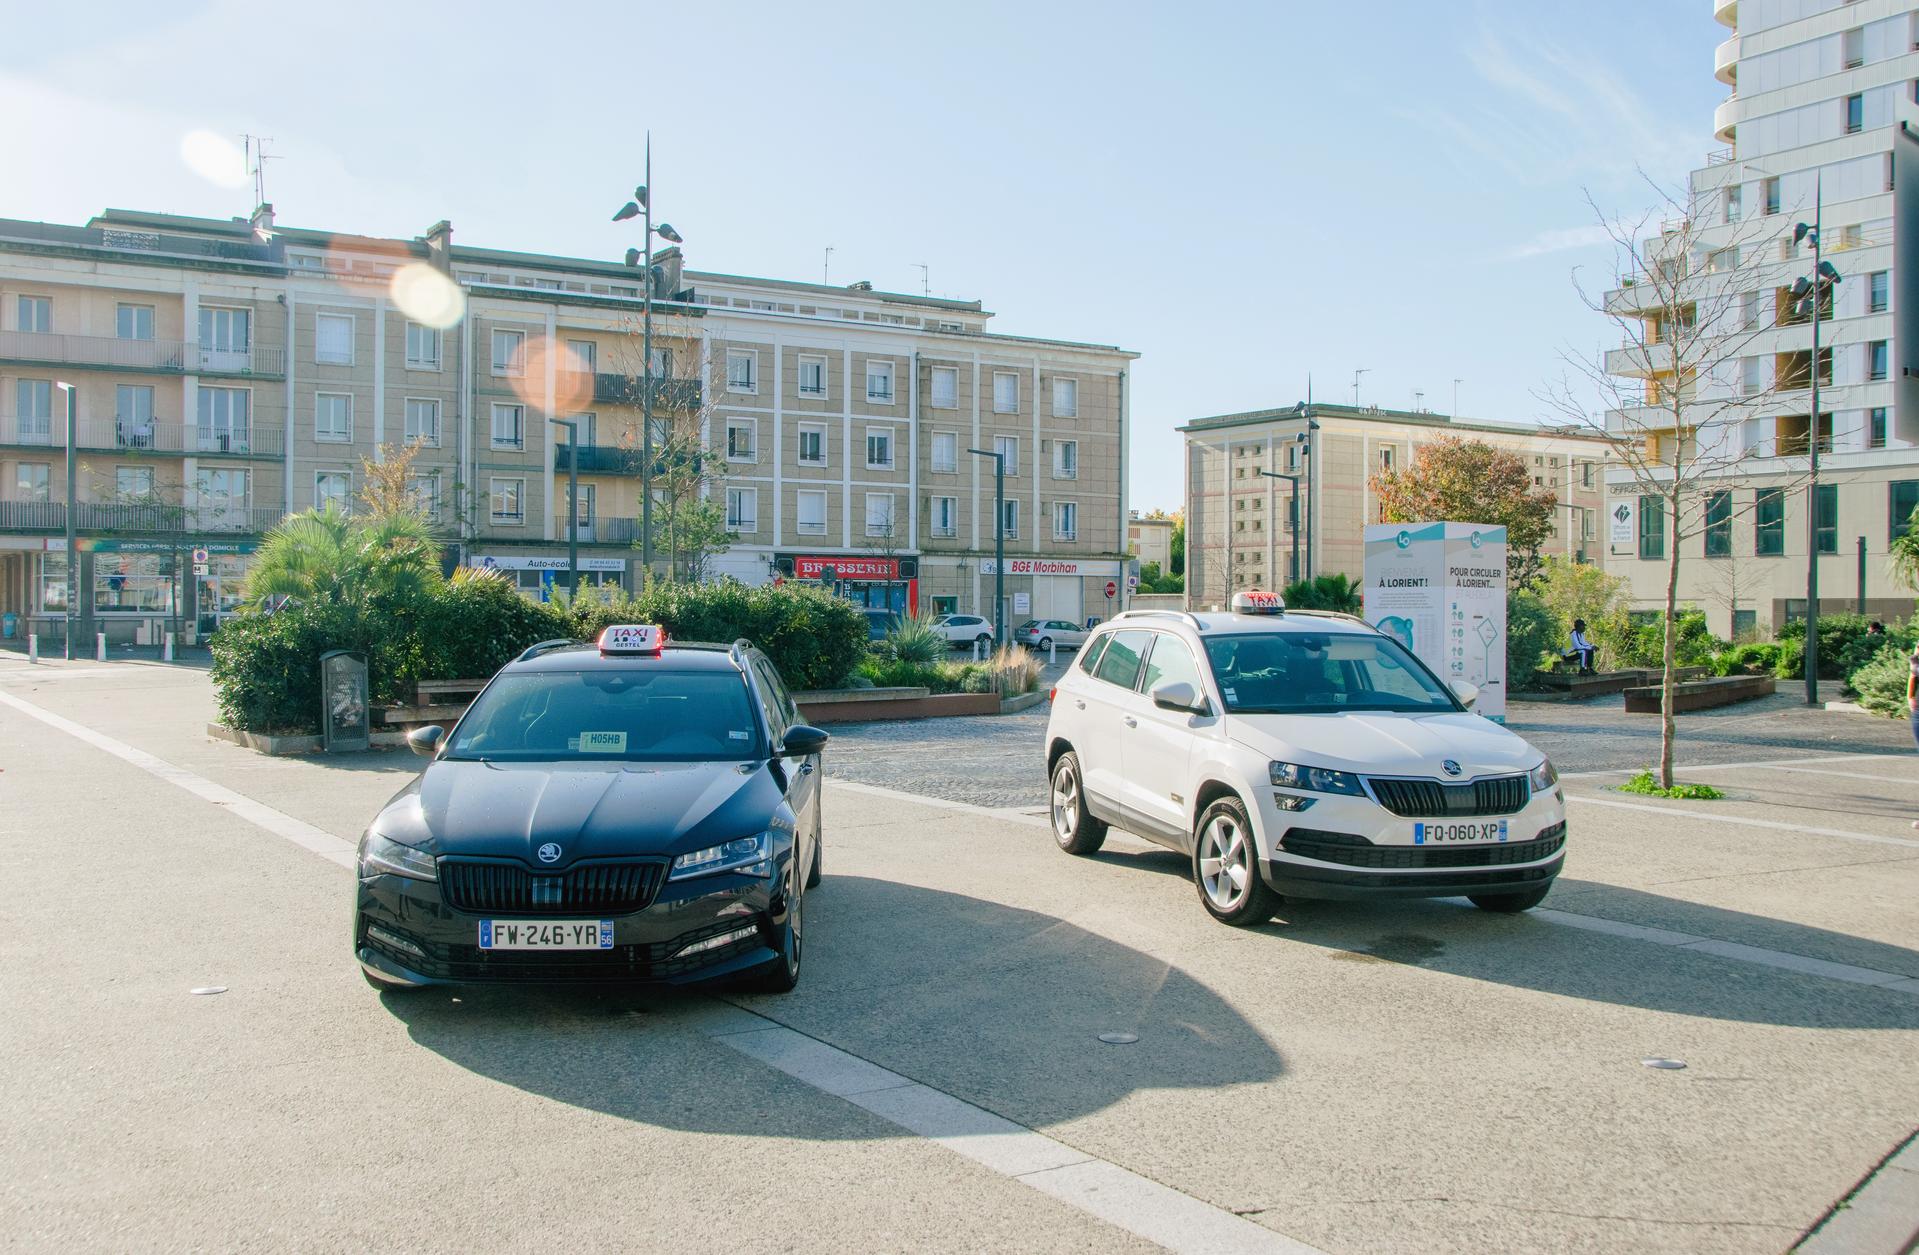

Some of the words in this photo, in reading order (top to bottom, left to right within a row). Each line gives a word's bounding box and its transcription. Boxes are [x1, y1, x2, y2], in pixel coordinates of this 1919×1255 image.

[802, 562, 892, 574] BRSSERIE
[1011, 560, 1031, 573] BGE
[1033, 561, 1077, 574] Morbihan
[1450, 567, 1469, 577] POUR
[1470, 567, 1501, 578] CIRCULER
[1379, 577, 1385, 588] À
[1387, 578, 1424, 588] LORIENT
[1456, 577, 1462, 588] À
[1248, 595, 1278, 604] TAXI
[613, 629, 648, 637] TAXI
[601, 934, 612, 945] 56
